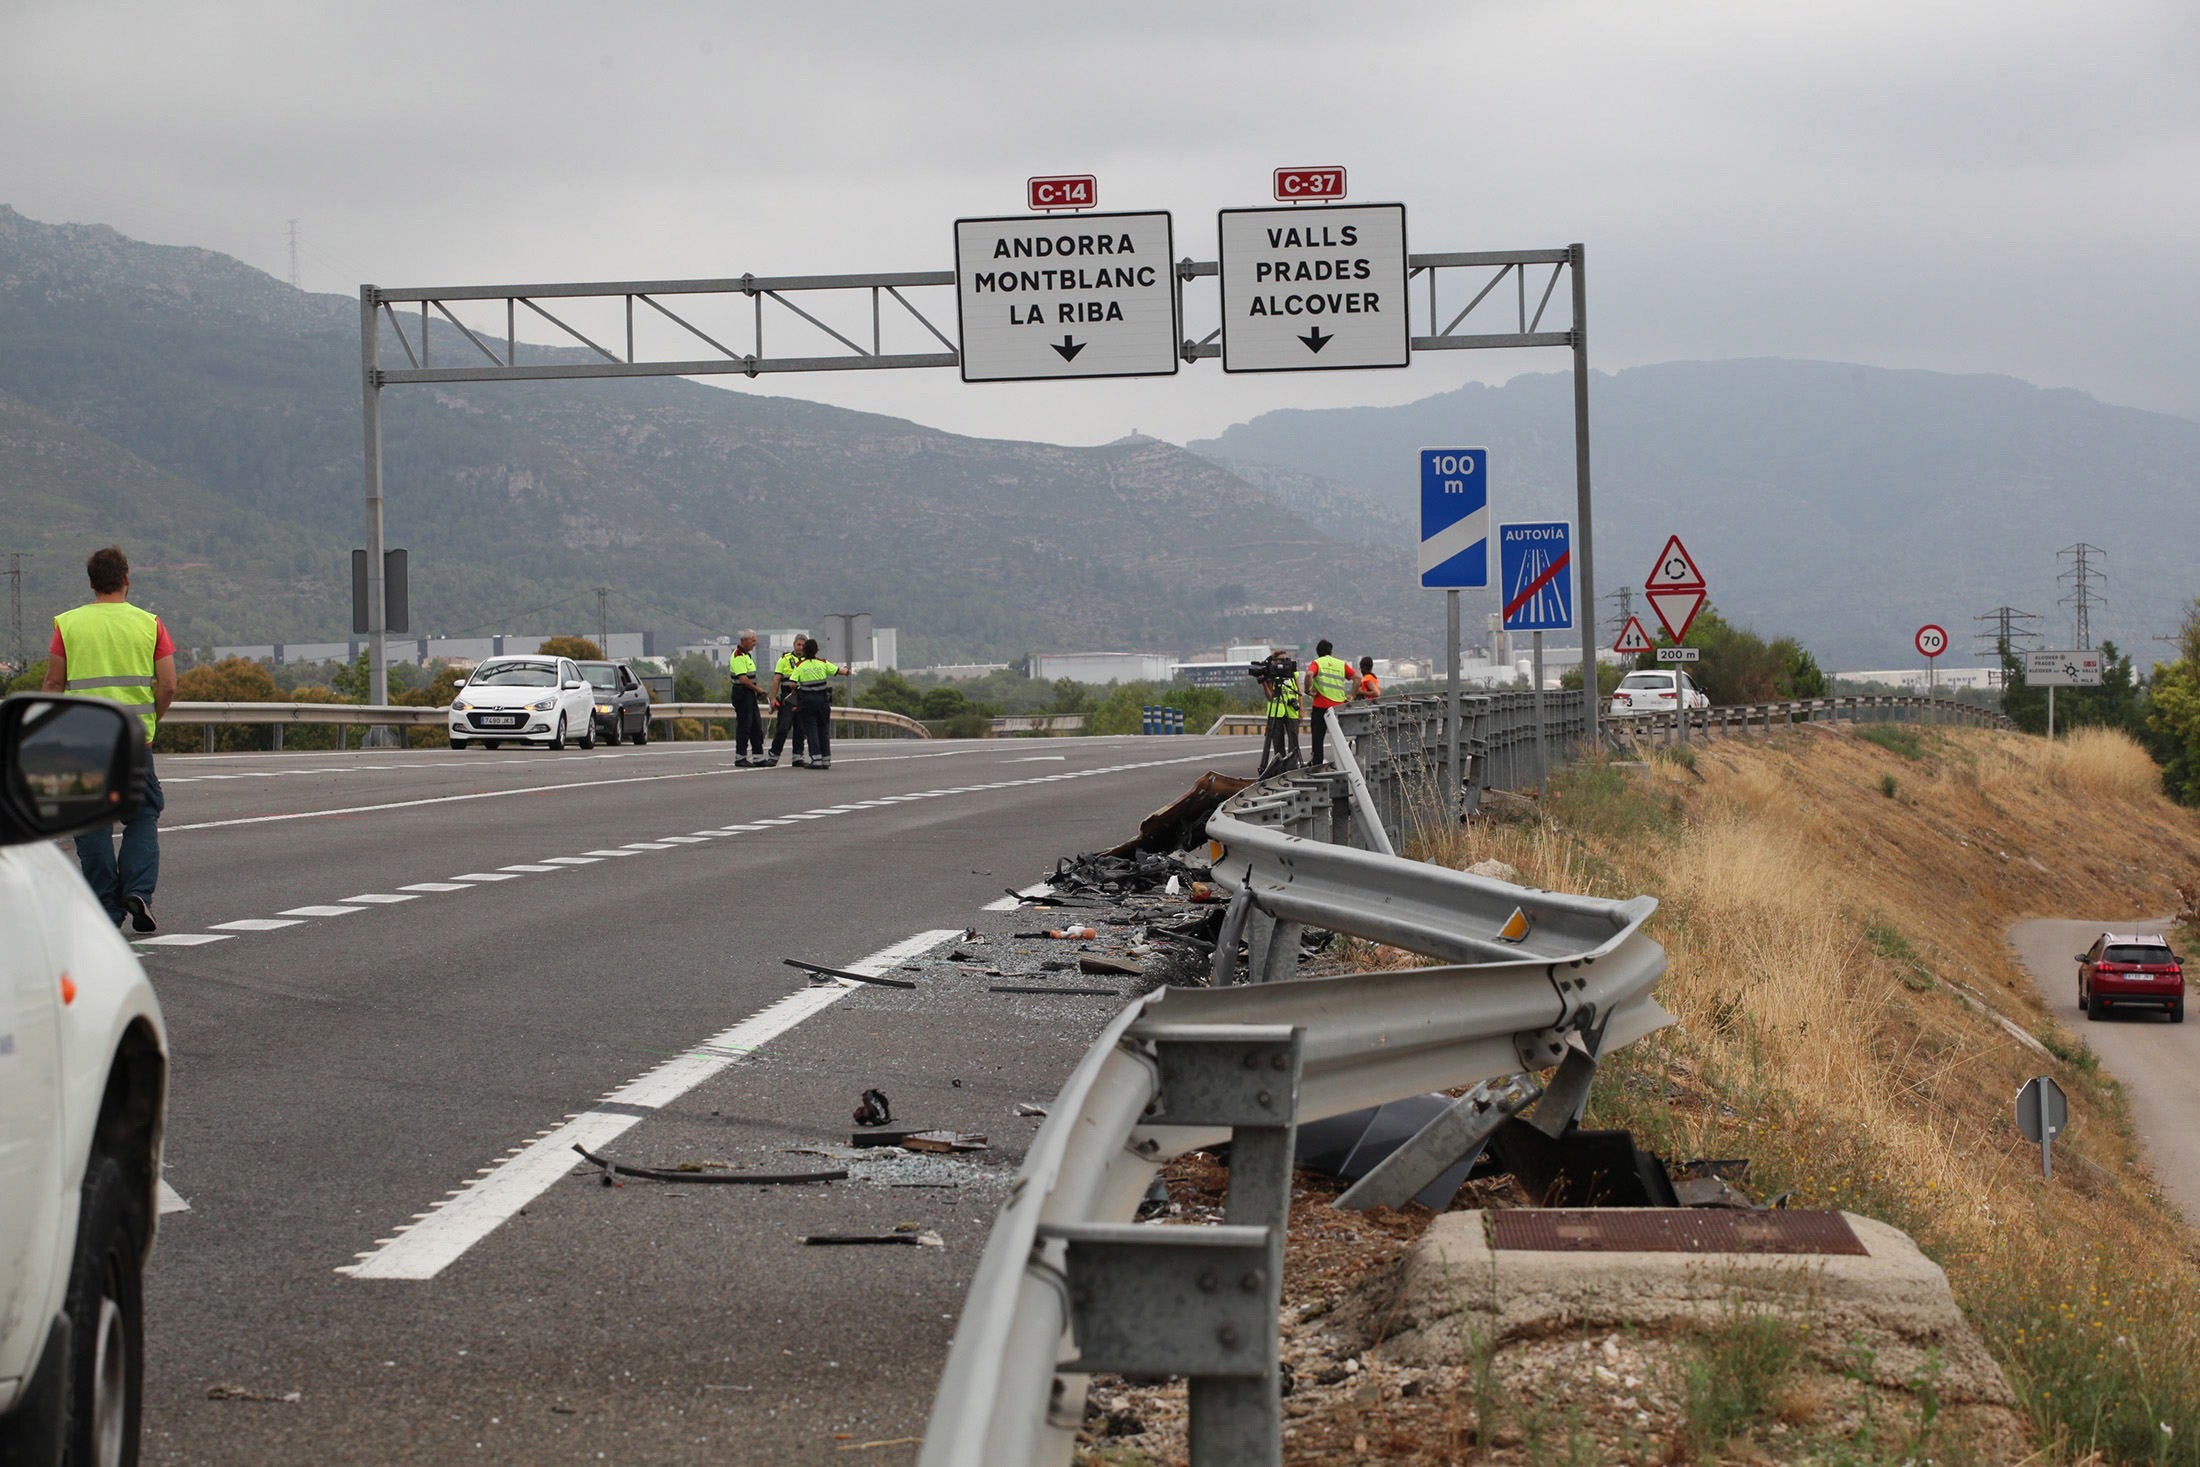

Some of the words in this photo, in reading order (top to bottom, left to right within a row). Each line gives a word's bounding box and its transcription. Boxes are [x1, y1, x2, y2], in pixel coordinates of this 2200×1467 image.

[1038, 183, 1087, 202] C-14
[1284, 174, 1336, 194] C-37
[993, 234, 1135, 259] ANDORRA
[1267, 225, 1358, 249] VALLS
[975, 266, 1156, 293] MONTBLANC
[1256, 258, 1371, 283] PRADES
[1010, 304, 1045, 325] LA
[1059, 301, 1124, 323] RIBA
[1249, 292, 1380, 317] ALCOVER
[1432, 455, 1475, 475] 100
[1444, 480, 1464, 494] m
[1505, 527, 1565, 541] AUTOVÍA
[1923, 636, 1940, 646] 70
[1661, 650, 1683, 659] 200
[1626, 698, 1633, 707] 3
